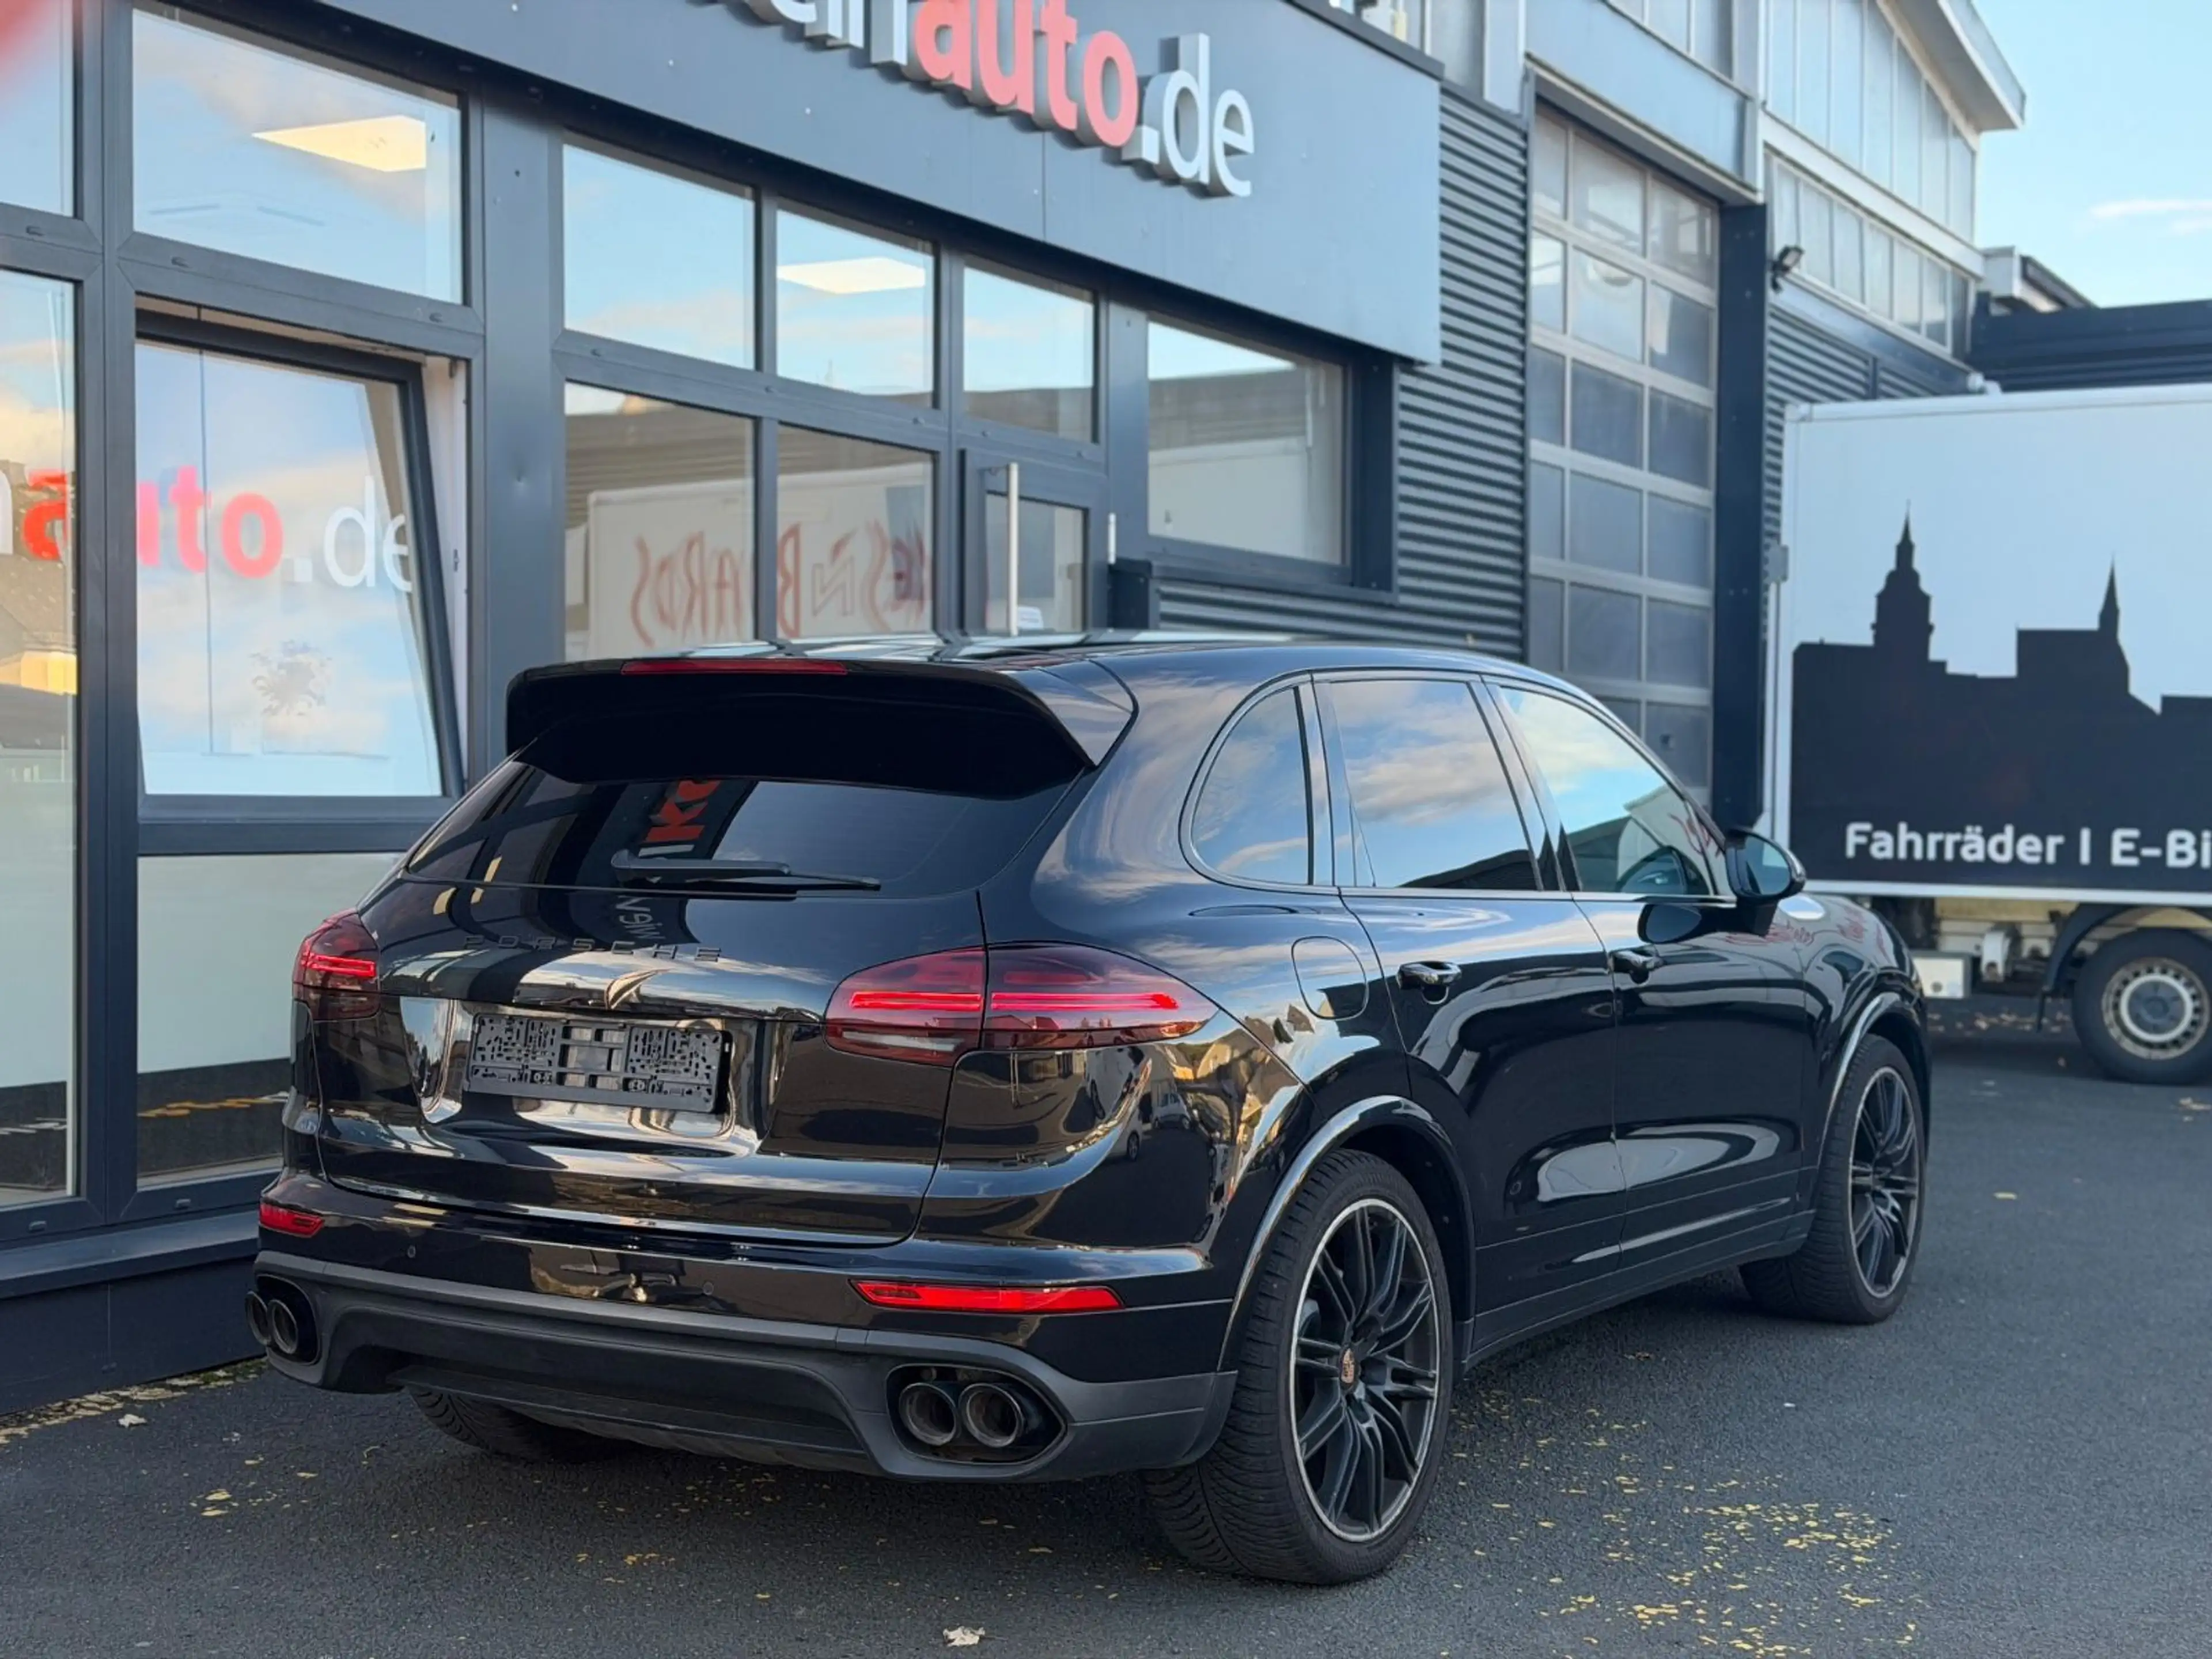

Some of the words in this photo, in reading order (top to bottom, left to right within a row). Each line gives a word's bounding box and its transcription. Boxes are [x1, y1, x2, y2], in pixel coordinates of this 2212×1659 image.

[1845, 821, 2065, 864] Fahrräder
[2111, 828, 2212, 869] E-Bi
[463, 934, 722, 963] PORSCHE
